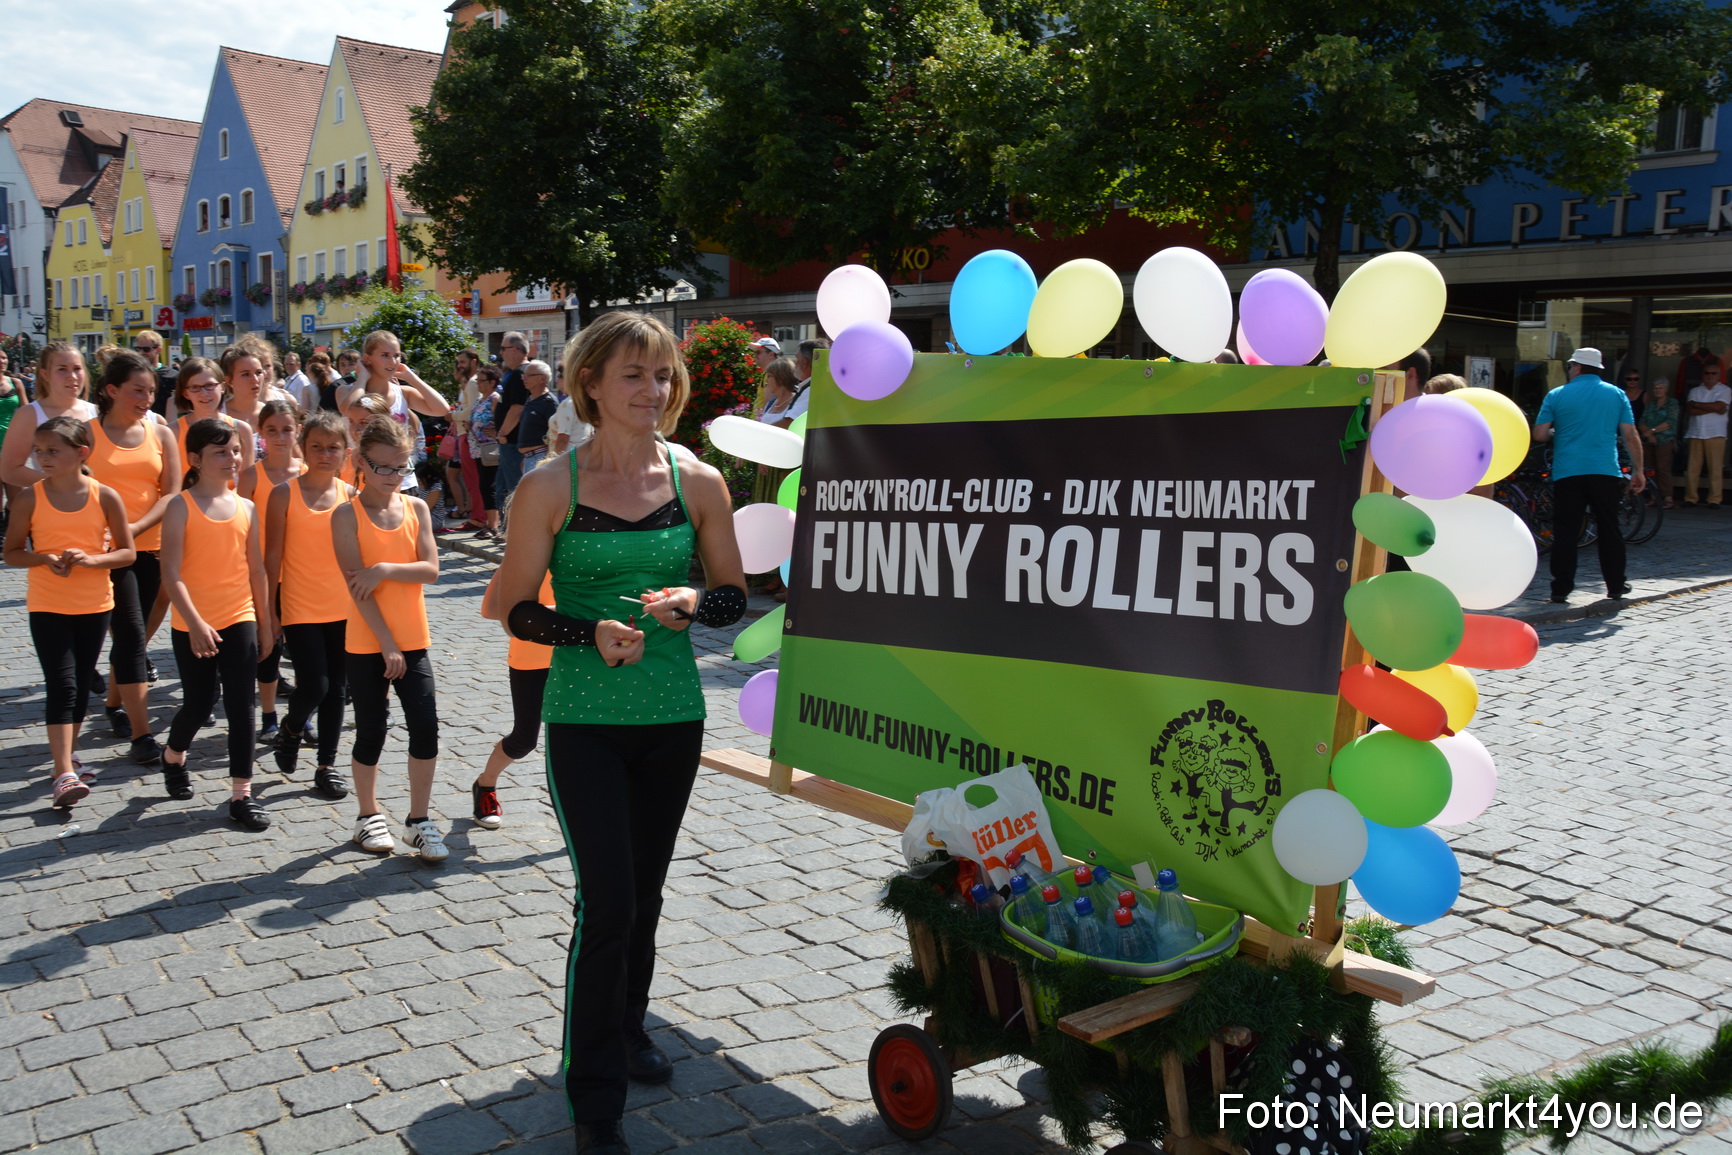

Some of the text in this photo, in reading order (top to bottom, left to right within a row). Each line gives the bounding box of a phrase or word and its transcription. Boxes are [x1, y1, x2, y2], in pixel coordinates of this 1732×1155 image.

[815, 478, 1033, 513] ROCK'N'ROLL-CLUB
[1062, 479, 1121, 516] DJK
[1130, 479, 1315, 521] NEUMARKT
[811, 521, 1315, 626] FUNNY ROLLERS
[1195, 841, 1219, 862] DJK
[1225, 827, 1268, 858] Neumarkt
